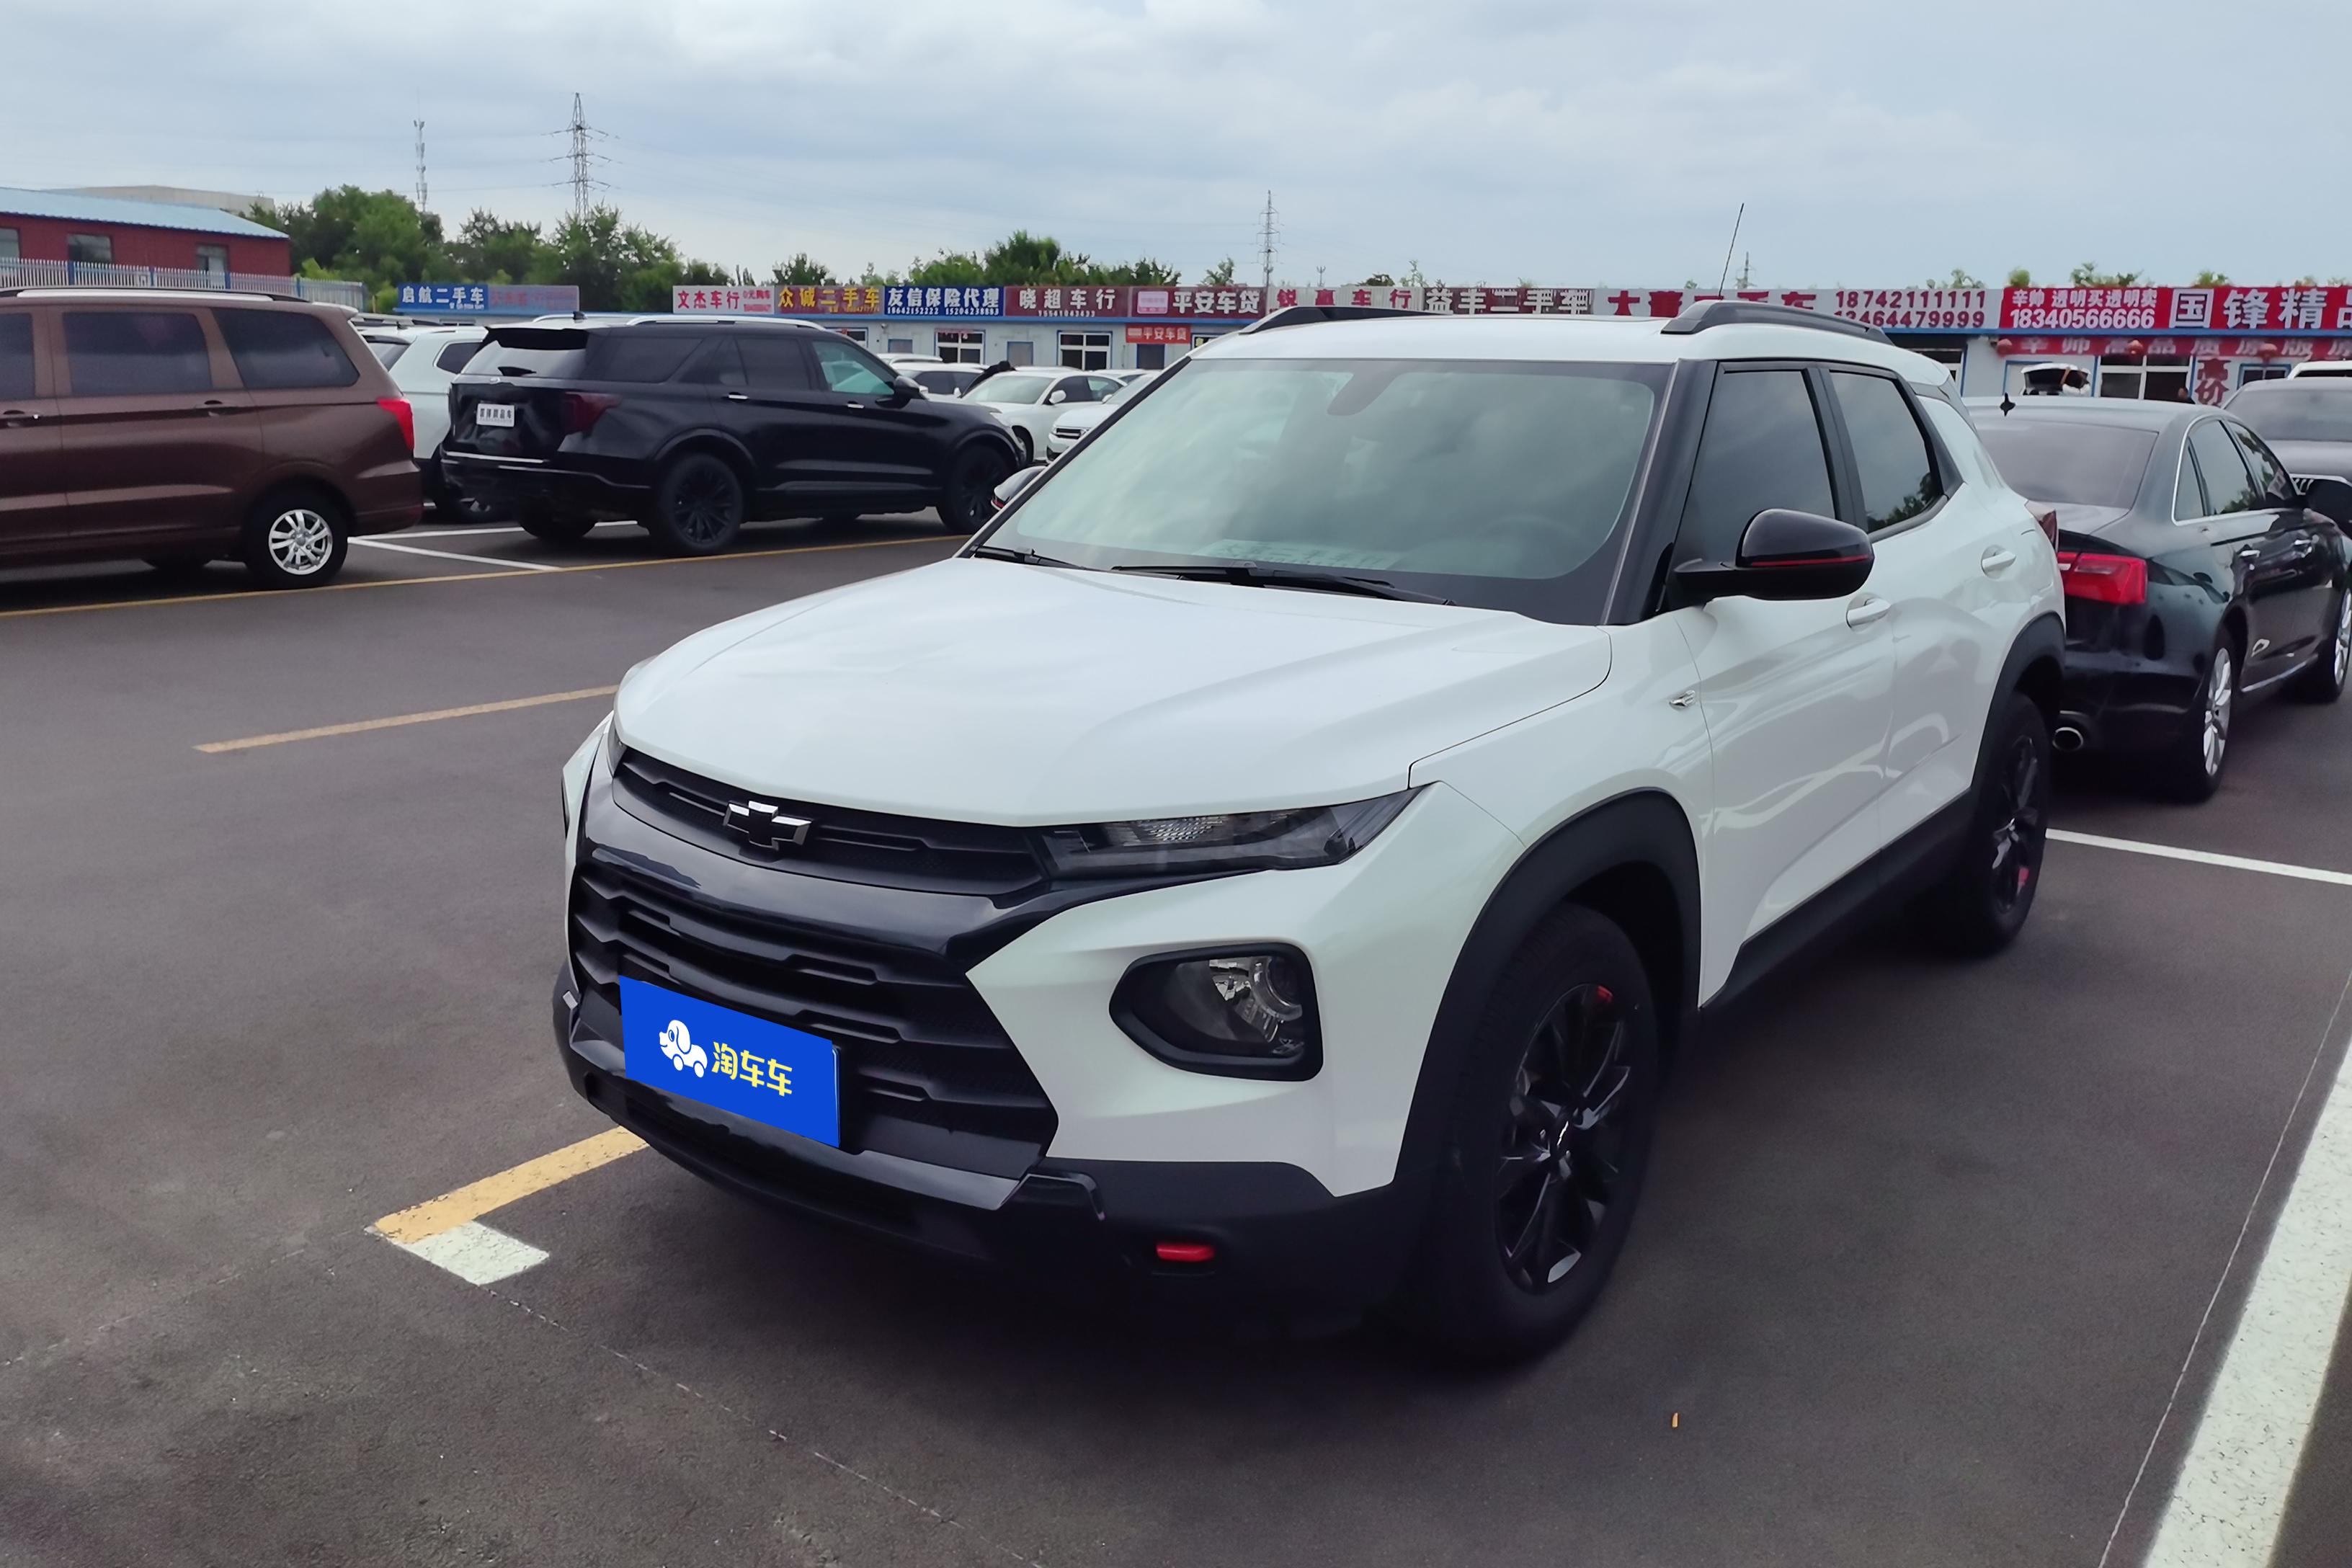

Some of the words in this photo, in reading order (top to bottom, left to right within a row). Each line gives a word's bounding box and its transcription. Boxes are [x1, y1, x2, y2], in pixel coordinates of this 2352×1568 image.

[402, 286, 484, 304] 启航二手车
[677, 290, 740, 310] 文杰车行
[778, 287, 879, 308] 众诚二手车
[888, 288, 999, 308] 友信保险代理
[1019, 288, 1115, 309] 晓超车行
[1172, 290, 1260, 314] 平安车贷
[1835, 290, 1985, 308] 18742111111
[2052, 289, 2157, 308] 透明买透明卖
[2010, 308, 2155, 329] 18340566666
